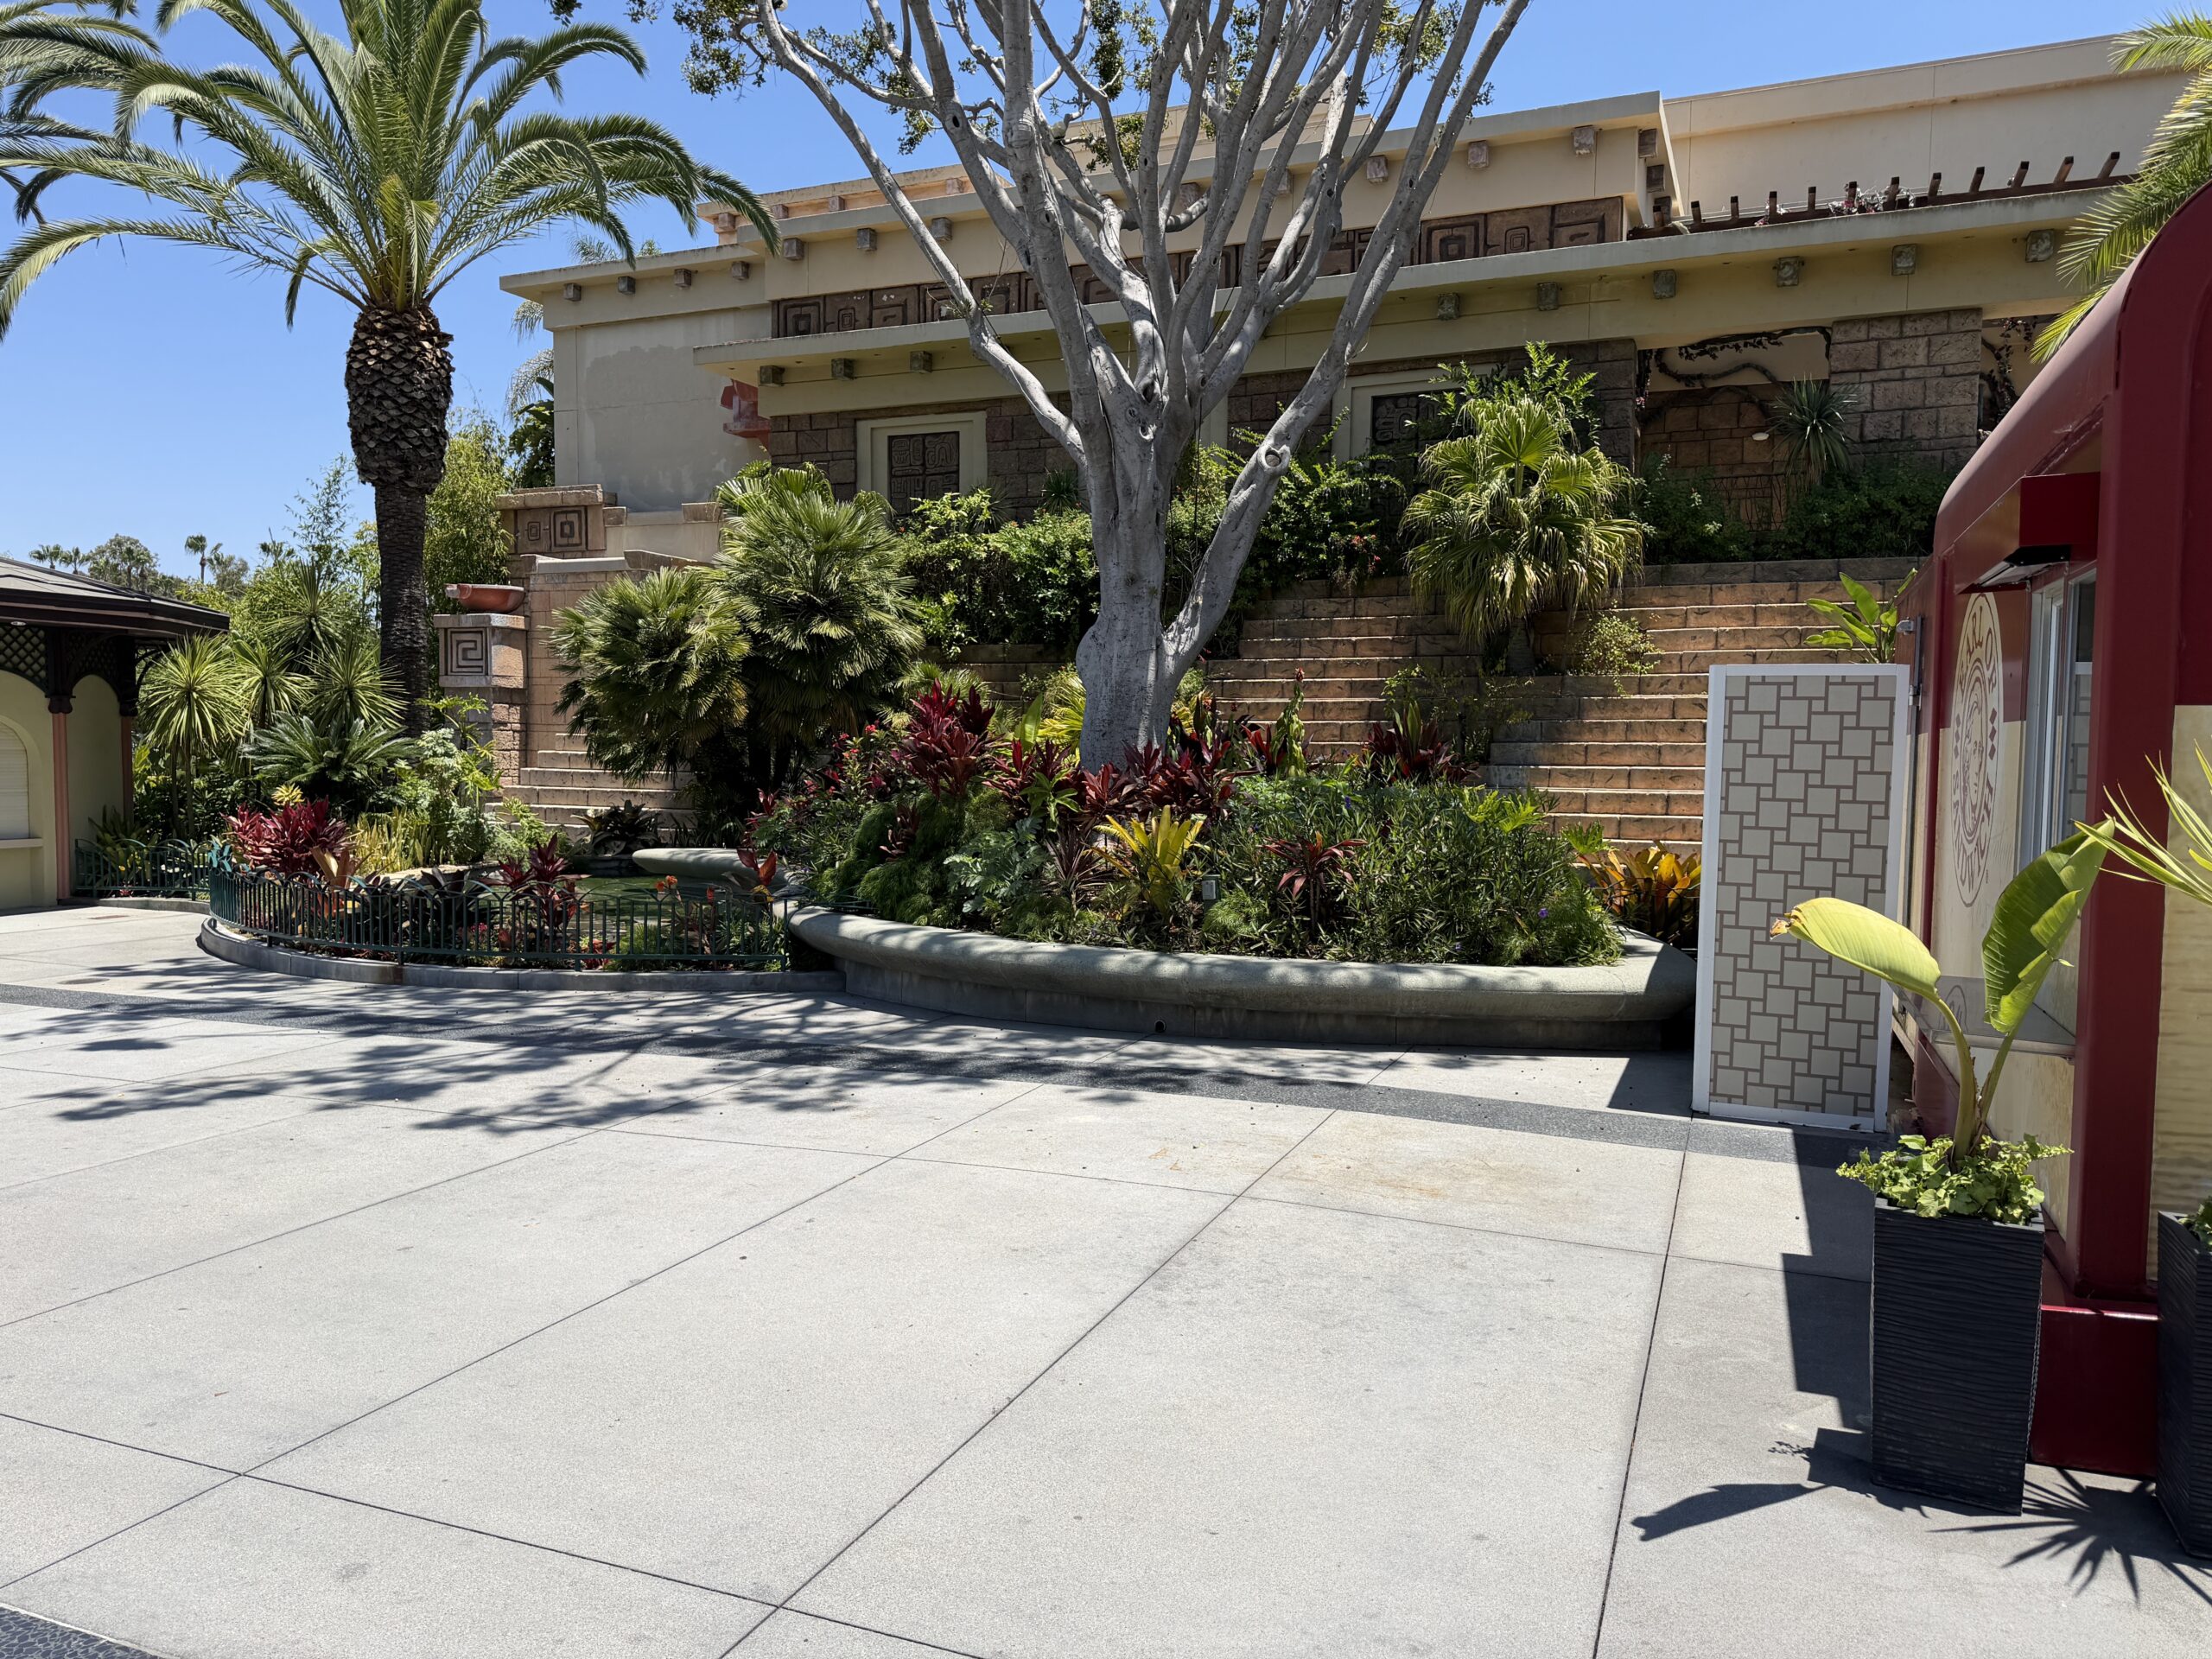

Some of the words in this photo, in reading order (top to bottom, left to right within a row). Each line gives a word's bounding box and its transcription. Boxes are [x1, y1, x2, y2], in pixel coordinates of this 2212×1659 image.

[1959, 605, 1984, 700] EARL
[1985, 627, 1997, 695] OF
[1952, 771, 1994, 893] SANDWICH
